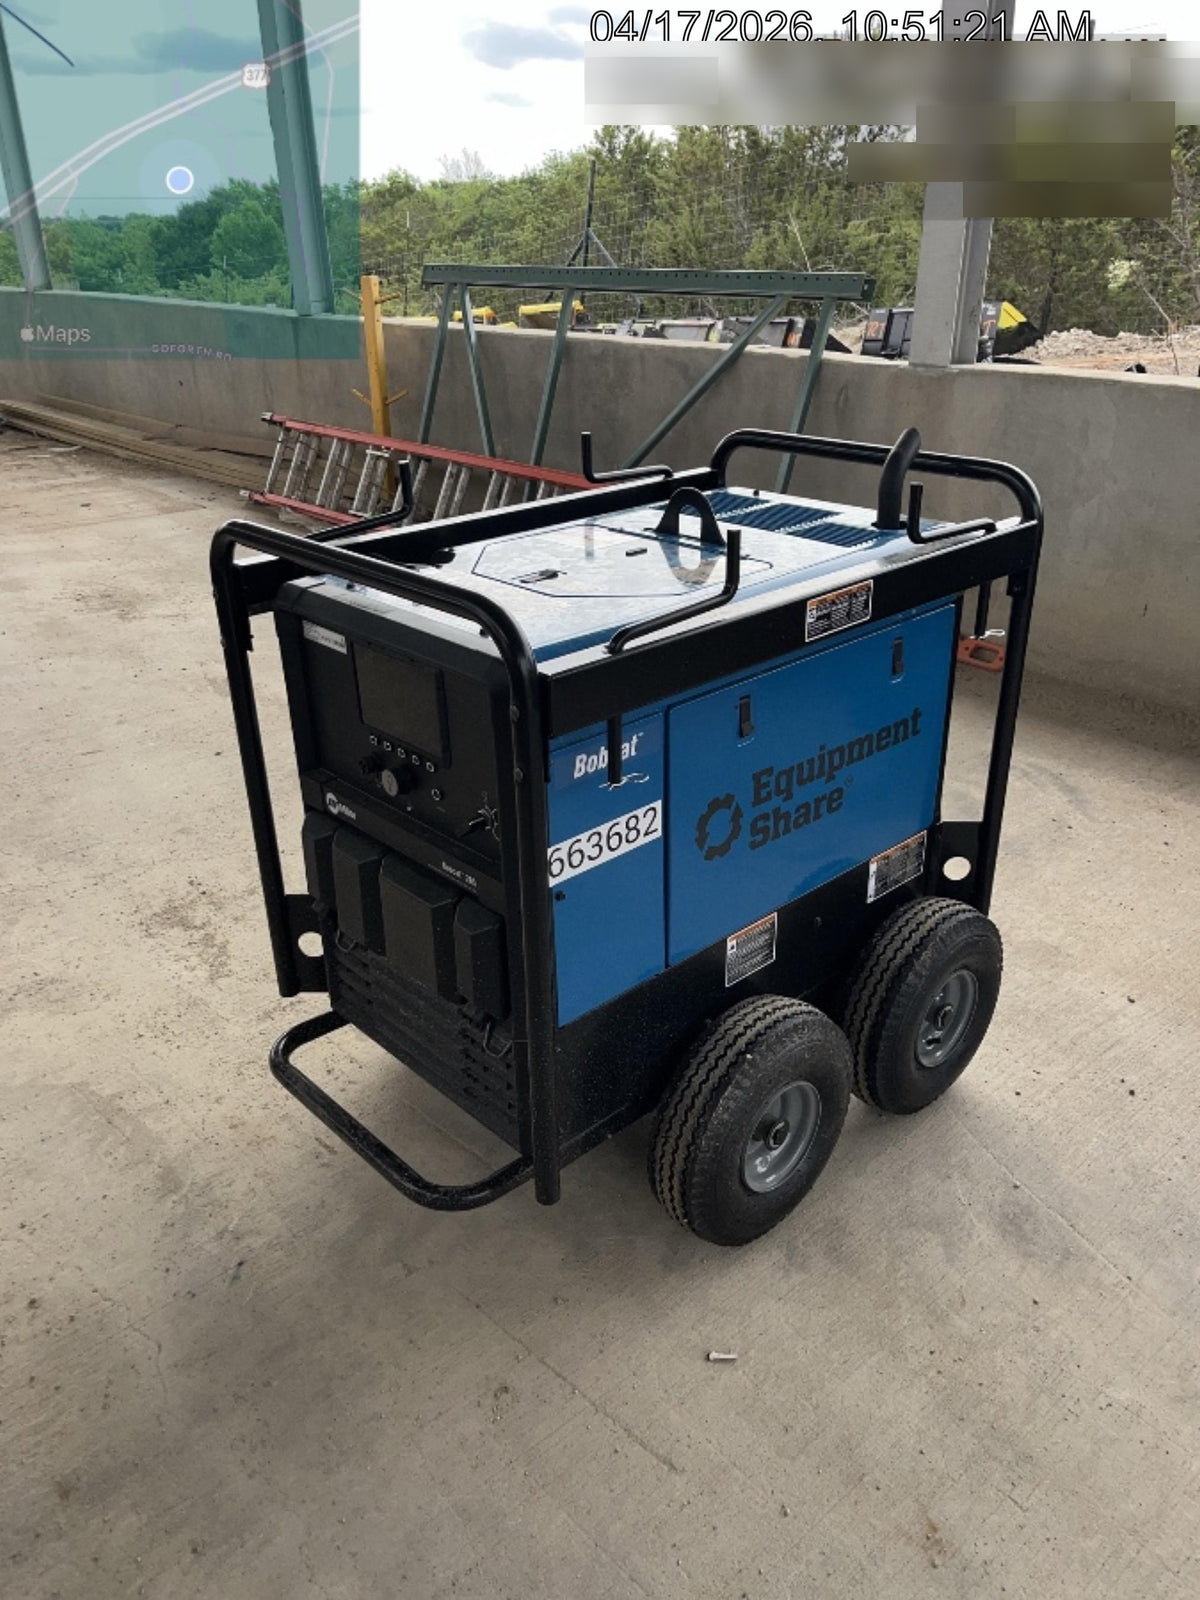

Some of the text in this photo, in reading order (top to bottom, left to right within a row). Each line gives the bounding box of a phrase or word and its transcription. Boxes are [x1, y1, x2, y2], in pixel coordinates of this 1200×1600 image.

[573, 734, 639, 780] Bobat
[752, 707, 922, 807] Equipment
[549, 806, 659, 878] 663682
[749, 786, 844, 850] Share
